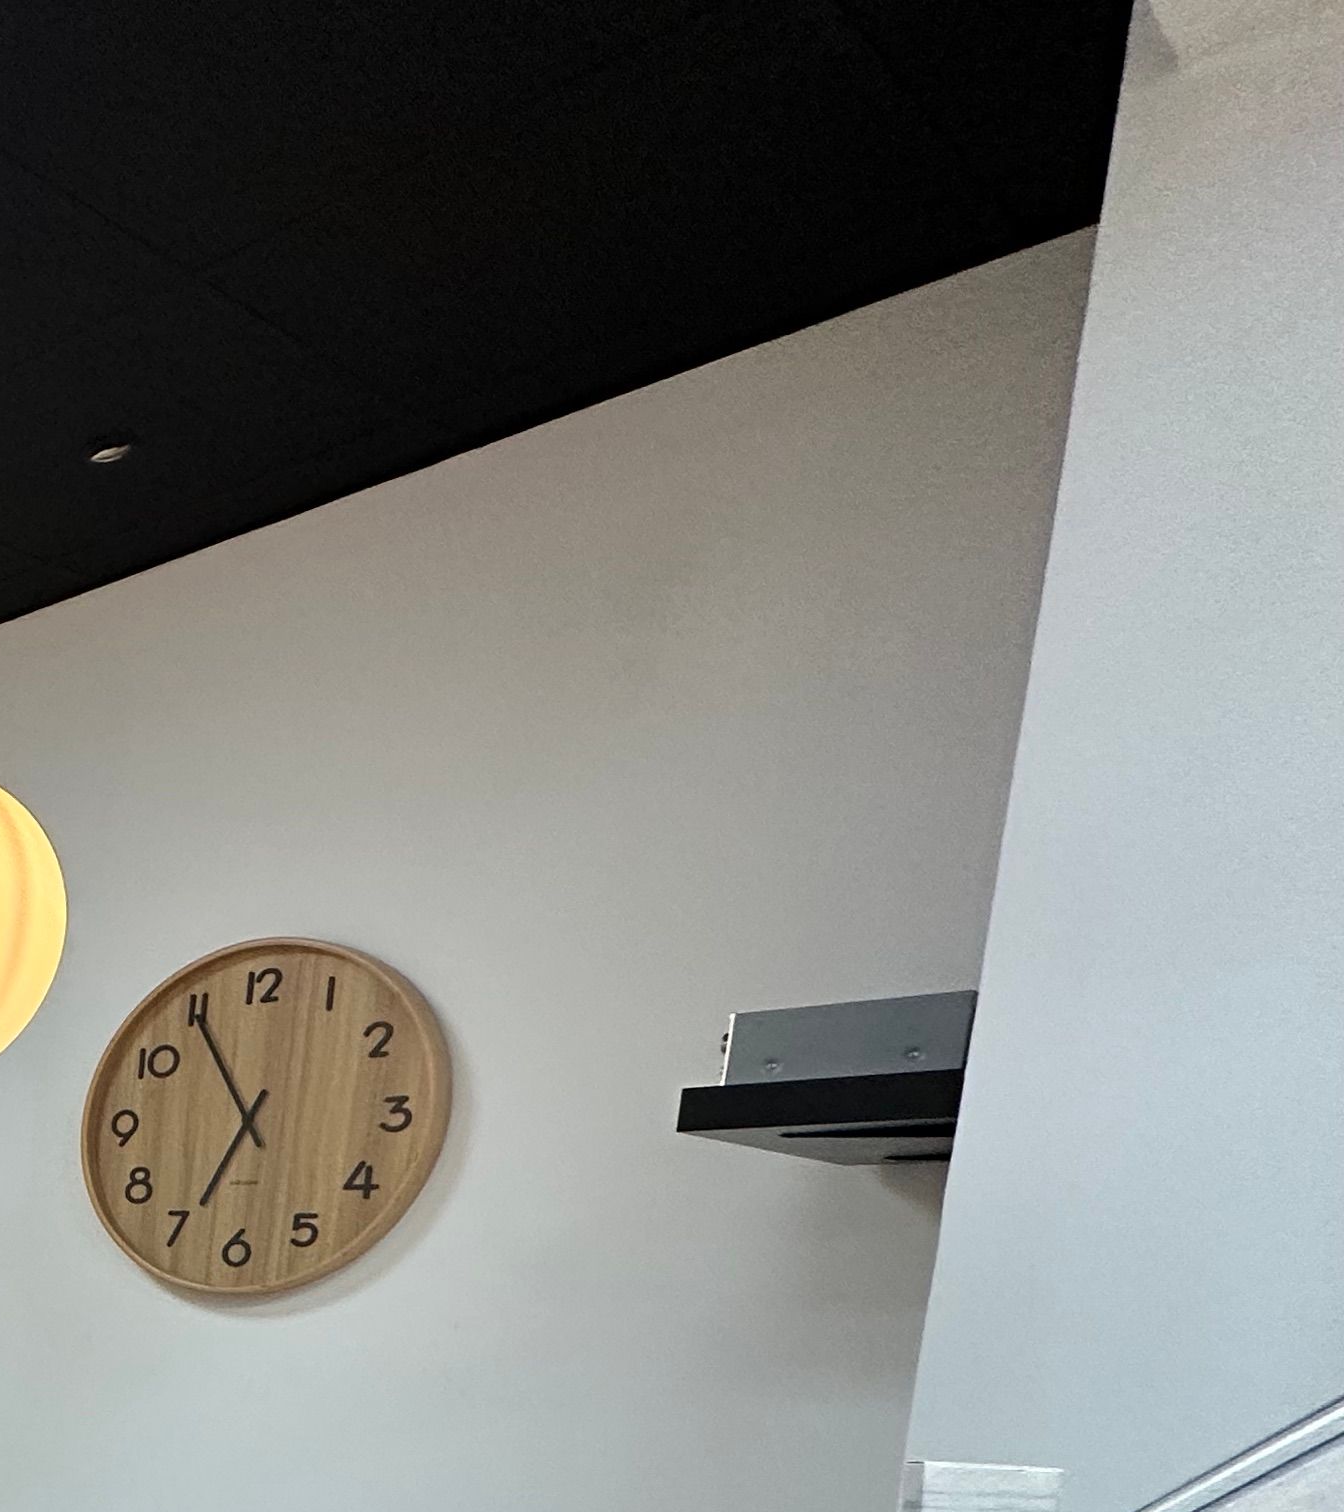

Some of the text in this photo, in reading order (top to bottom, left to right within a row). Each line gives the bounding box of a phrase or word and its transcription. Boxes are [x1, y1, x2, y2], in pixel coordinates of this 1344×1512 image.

[245, 967, 283, 1005] 12
[326, 975, 336, 1011] 1
[188, 992, 209, 1027] 11
[362, 1020, 394, 1058] 2
[137, 1044, 180, 1080] 10
[111, 1108, 139, 1147] 9
[379, 1095, 413, 1132] 3
[124, 1167, 153, 1204] 8
[343, 1160, 379, 1199] 4
[167, 1210, 190, 1247] 7
[290, 1212, 319, 1247] 5
[221, 1228, 252, 1267] 6
